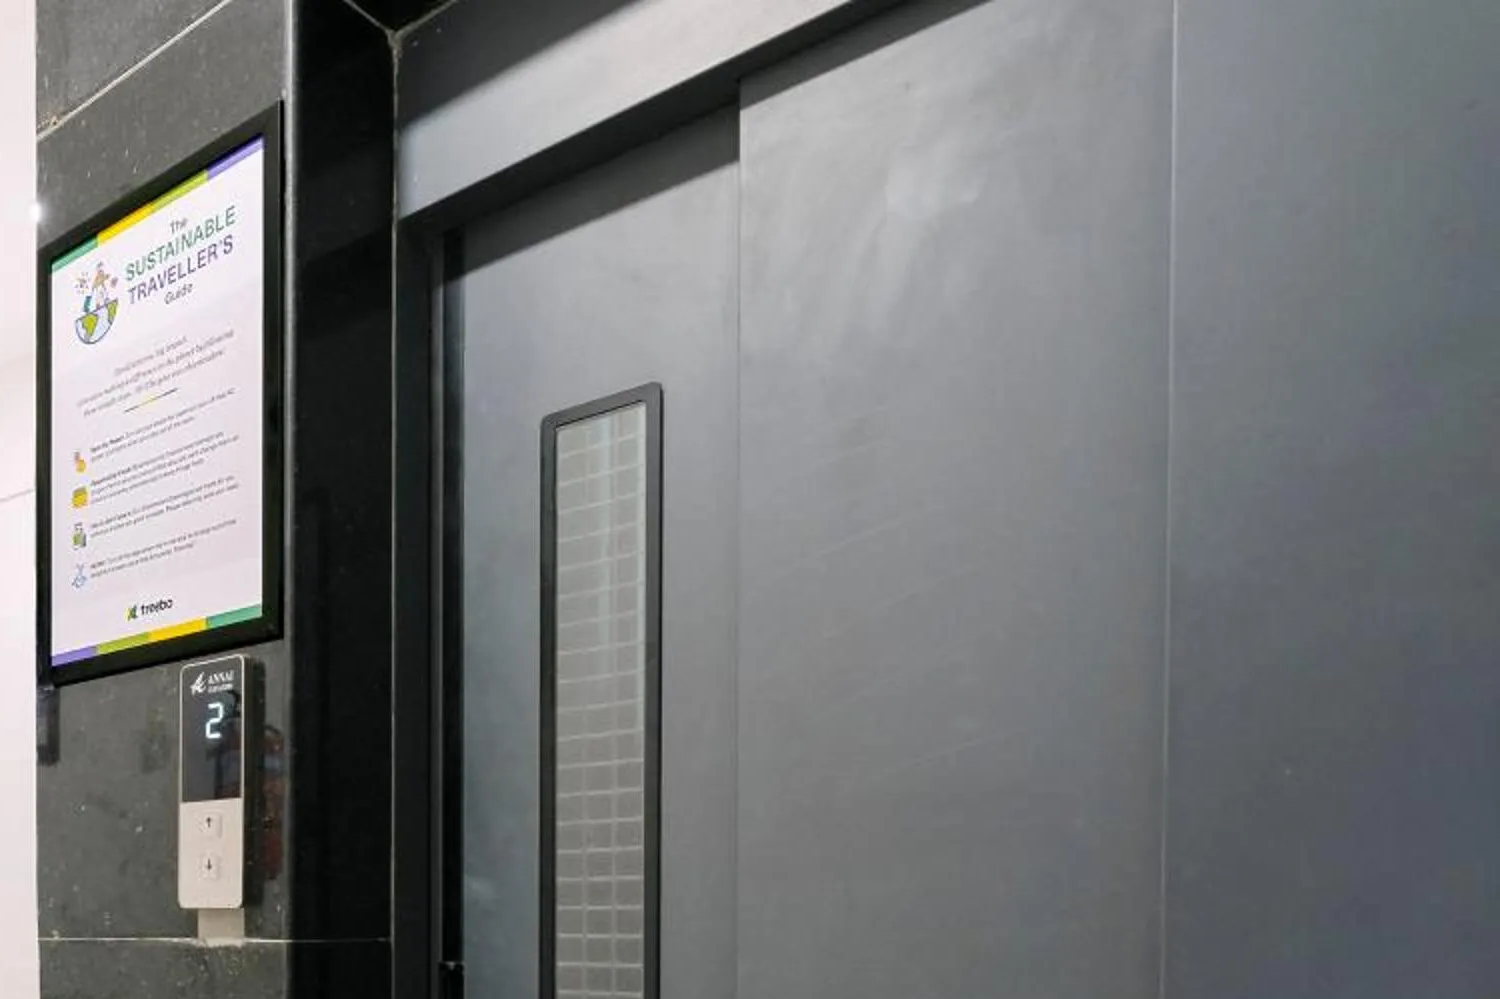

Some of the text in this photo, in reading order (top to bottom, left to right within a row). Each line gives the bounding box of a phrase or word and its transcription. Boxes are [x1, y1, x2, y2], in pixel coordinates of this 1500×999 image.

[125, 205, 236, 282] SUSTAINABLE
[128, 234, 234, 304] TRAVELLER'S
[164, 284, 193, 305] Guide
[141, 598, 174, 616] treebo
[204, 701, 224, 739] 2
